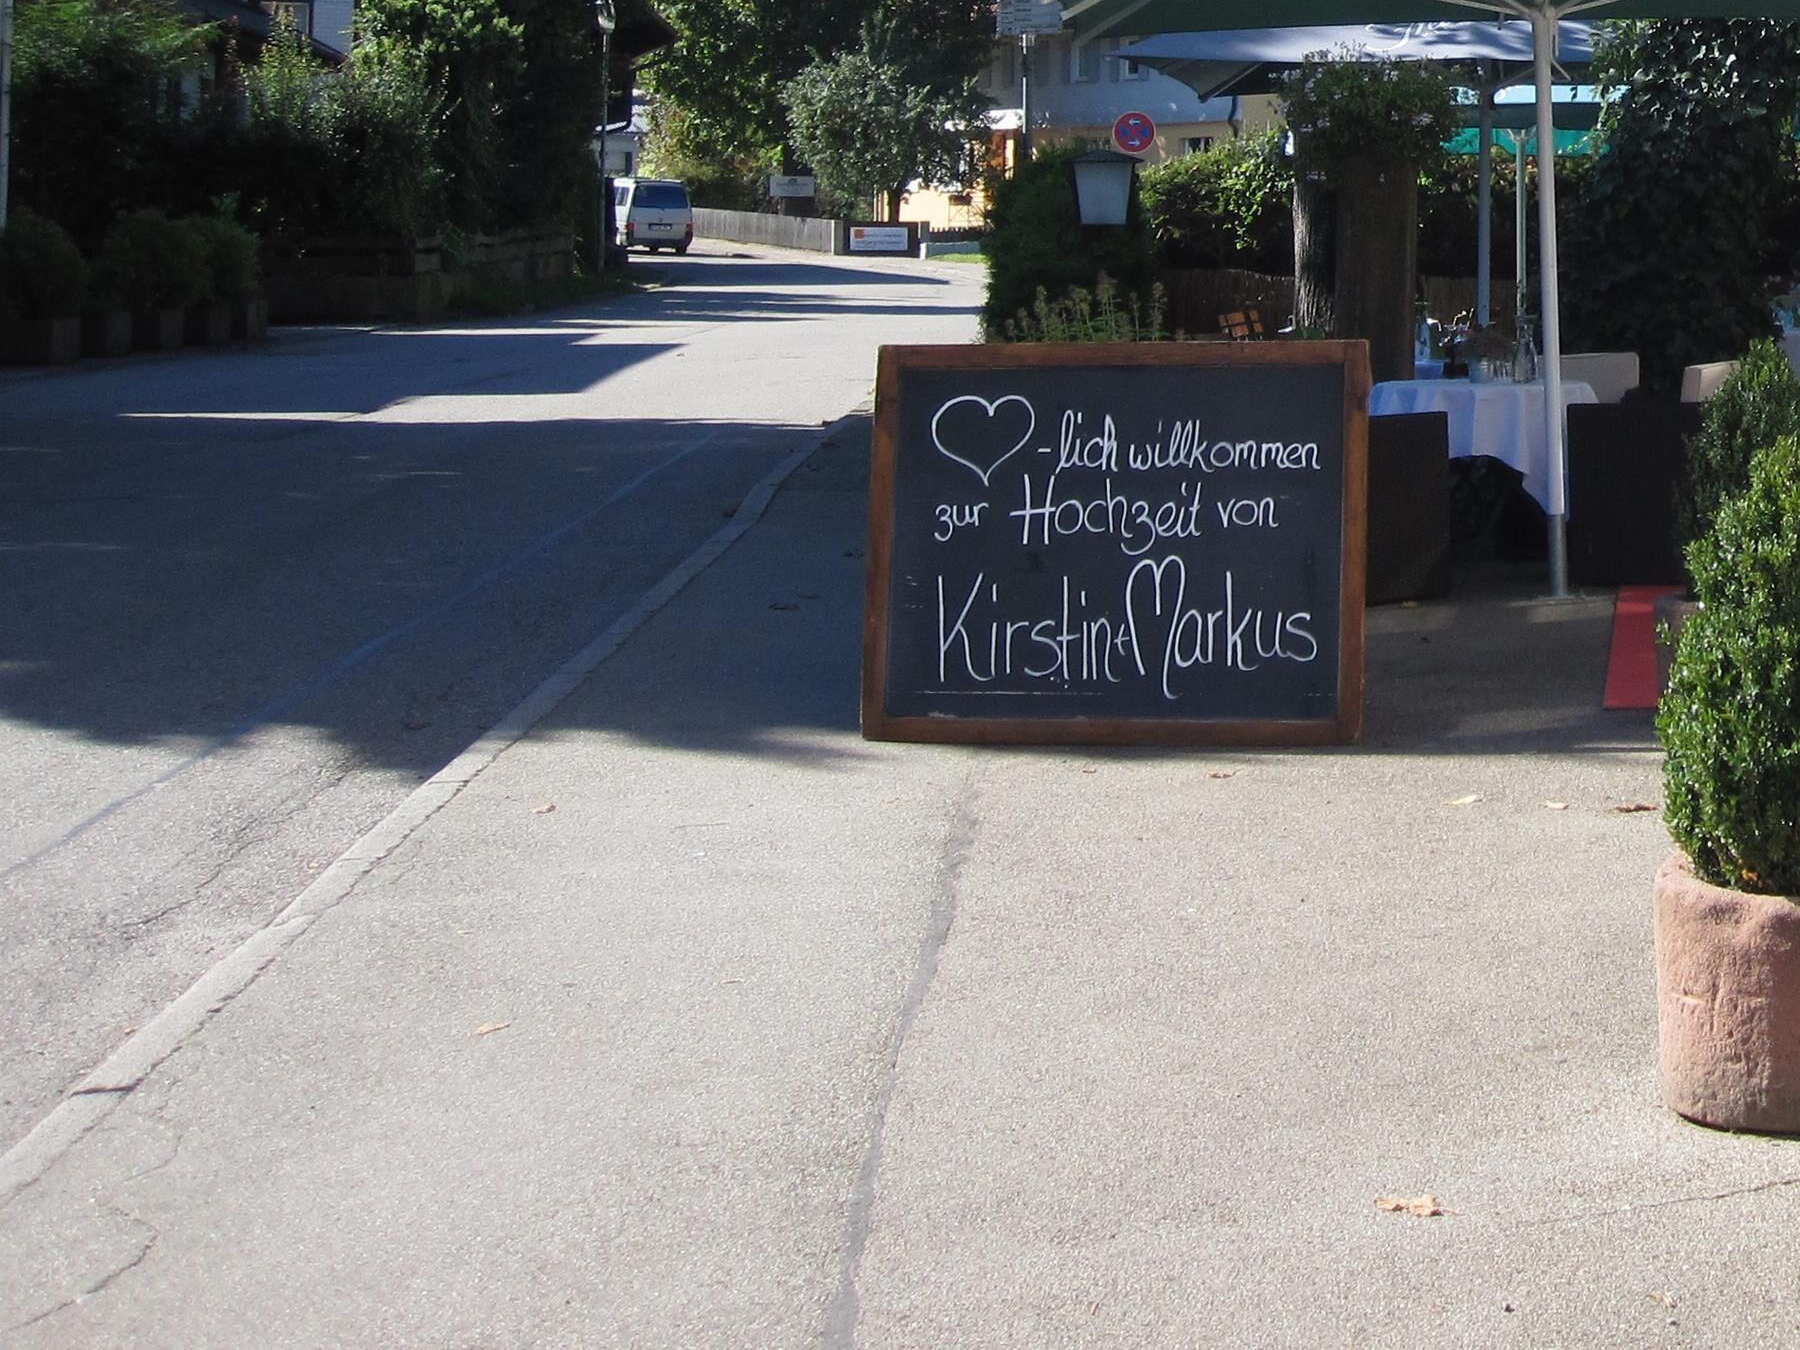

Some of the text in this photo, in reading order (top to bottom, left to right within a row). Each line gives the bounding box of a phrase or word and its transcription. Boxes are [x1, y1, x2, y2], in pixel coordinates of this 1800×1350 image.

[1129, 419, 1321, 473] willkommen
[933, 473, 1279, 555] zur Hochzeit von
[937, 572, 1121, 682] Kirstin
[1125, 554, 1318, 700] Markus
